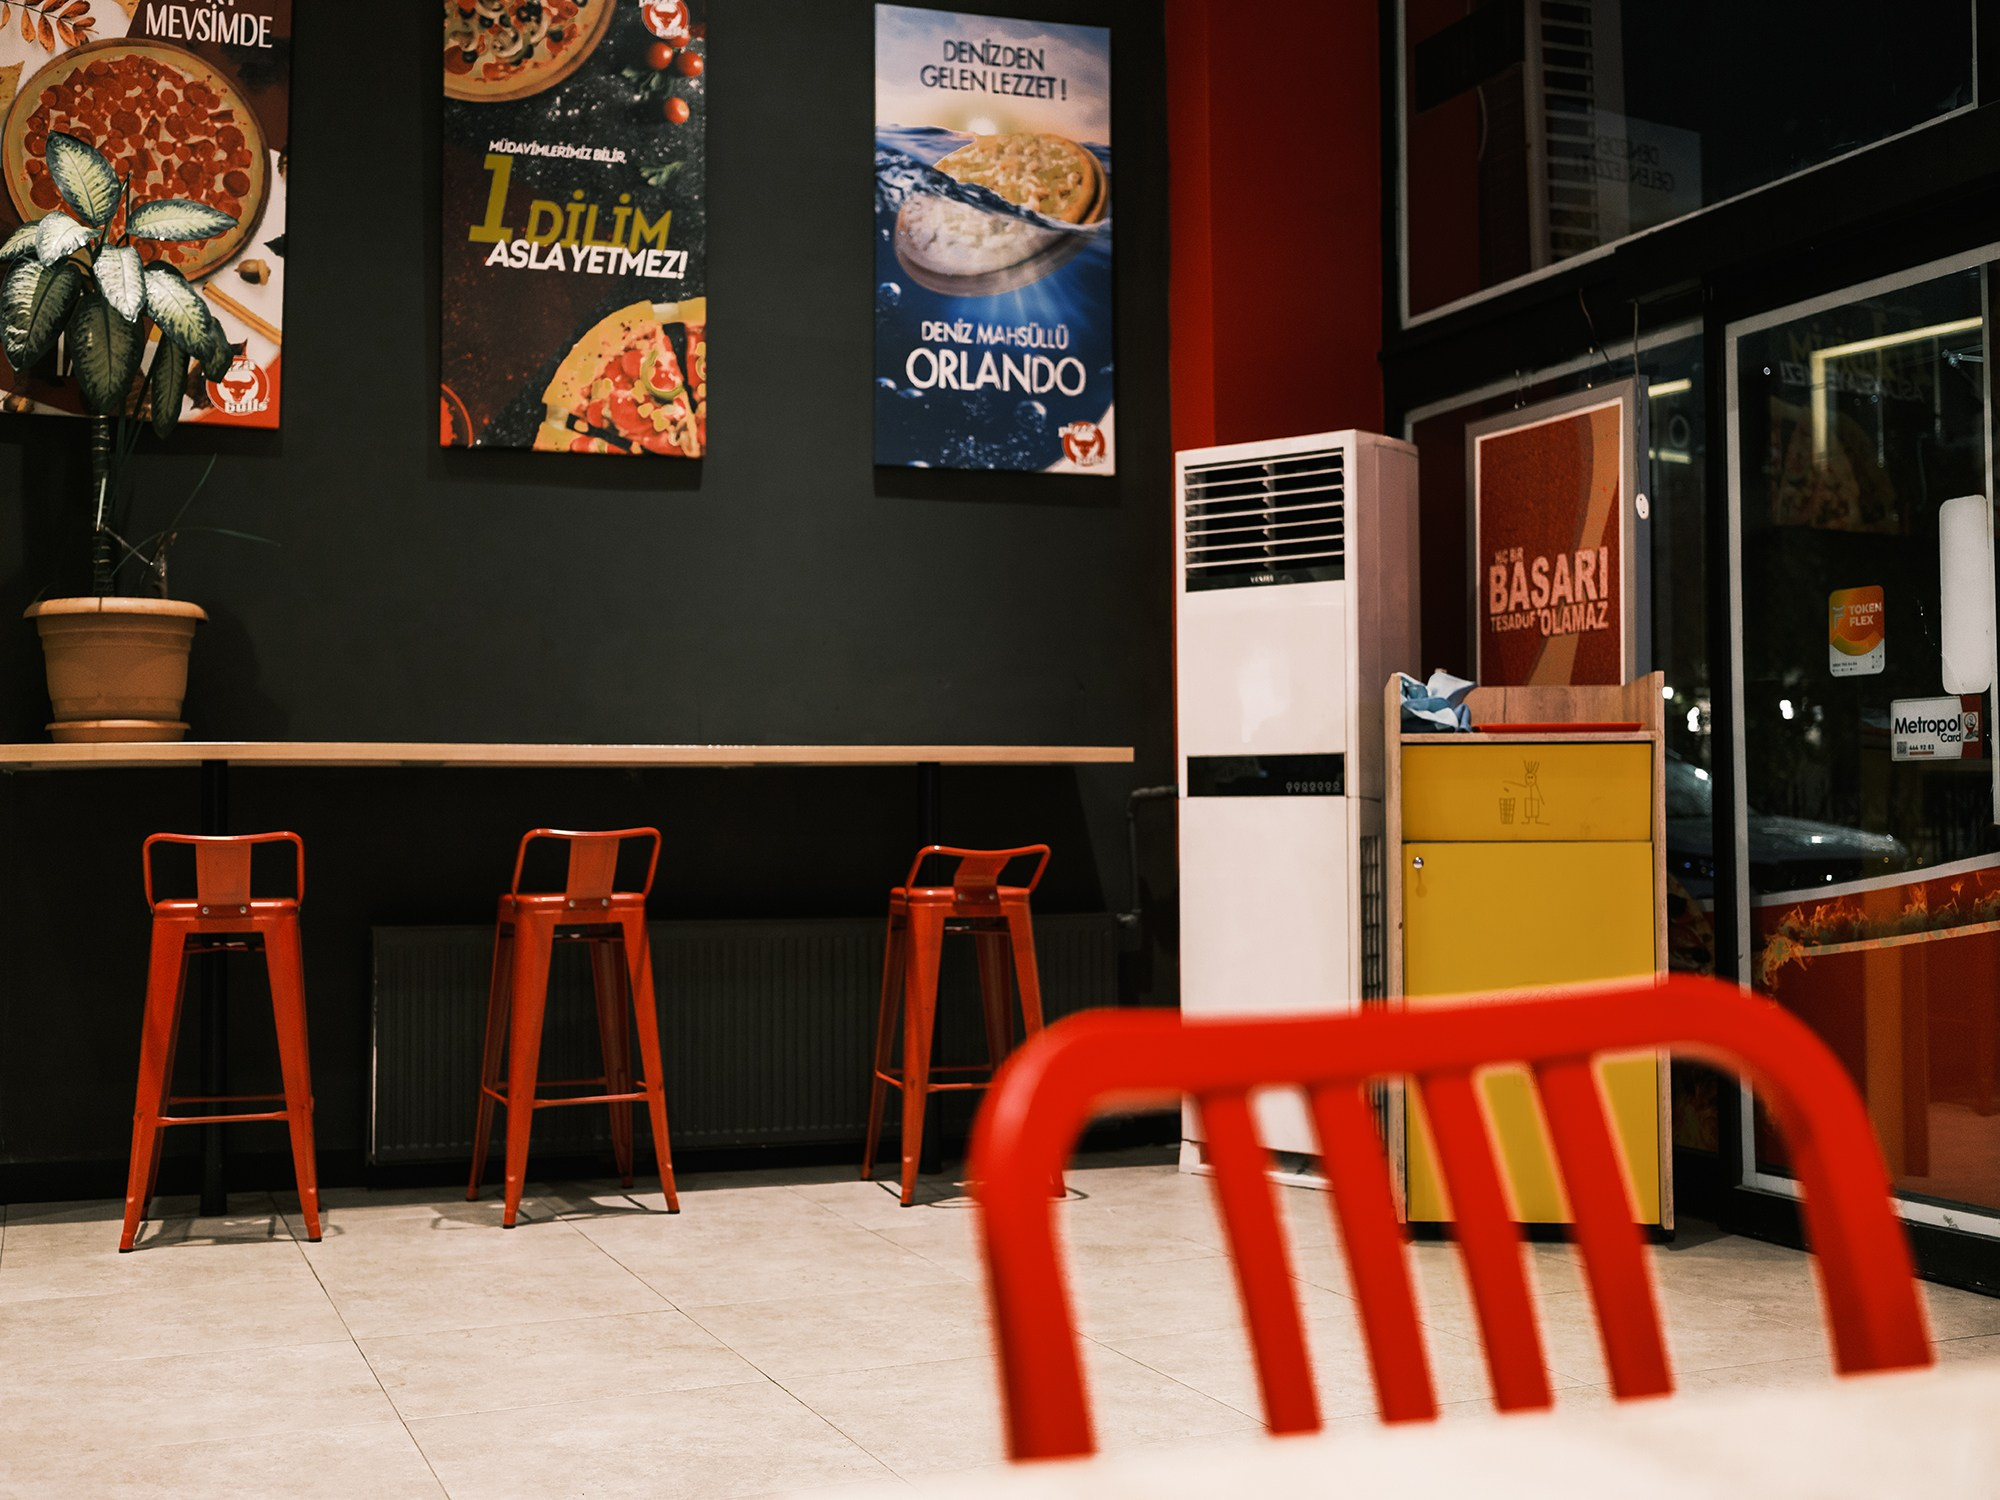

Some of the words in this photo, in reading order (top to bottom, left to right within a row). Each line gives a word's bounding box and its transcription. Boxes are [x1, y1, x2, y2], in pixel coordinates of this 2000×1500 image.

[145, 2, 273, 48] MEVSİMDE
[943, 38, 1045, 71] DENİZDEN
[920, 64, 987, 92] GELEN
[991, 72, 1057, 99] LEZZET
[488, 138, 592, 161] MÜDAVİMLERİMİZ
[468, 153, 514, 243] 1
[523, 189, 673, 254] DİLİM
[485, 239, 566, 272] ASLA
[571, 245, 689, 280] YETMEZ!
[921, 318, 974, 344] DENİZ
[976, 322, 1070, 350] MAHSÜLLÜ
[906, 347, 1087, 397] ORLANDO
[1540, 602, 1609, 637] OLAMAZ
[1849, 602, 1883, 615] TOKEN
[1849, 615, 1874, 627] FLEX
[1894, 713, 1961, 736] Metropol
[1941, 733, 1961, 743] Card
